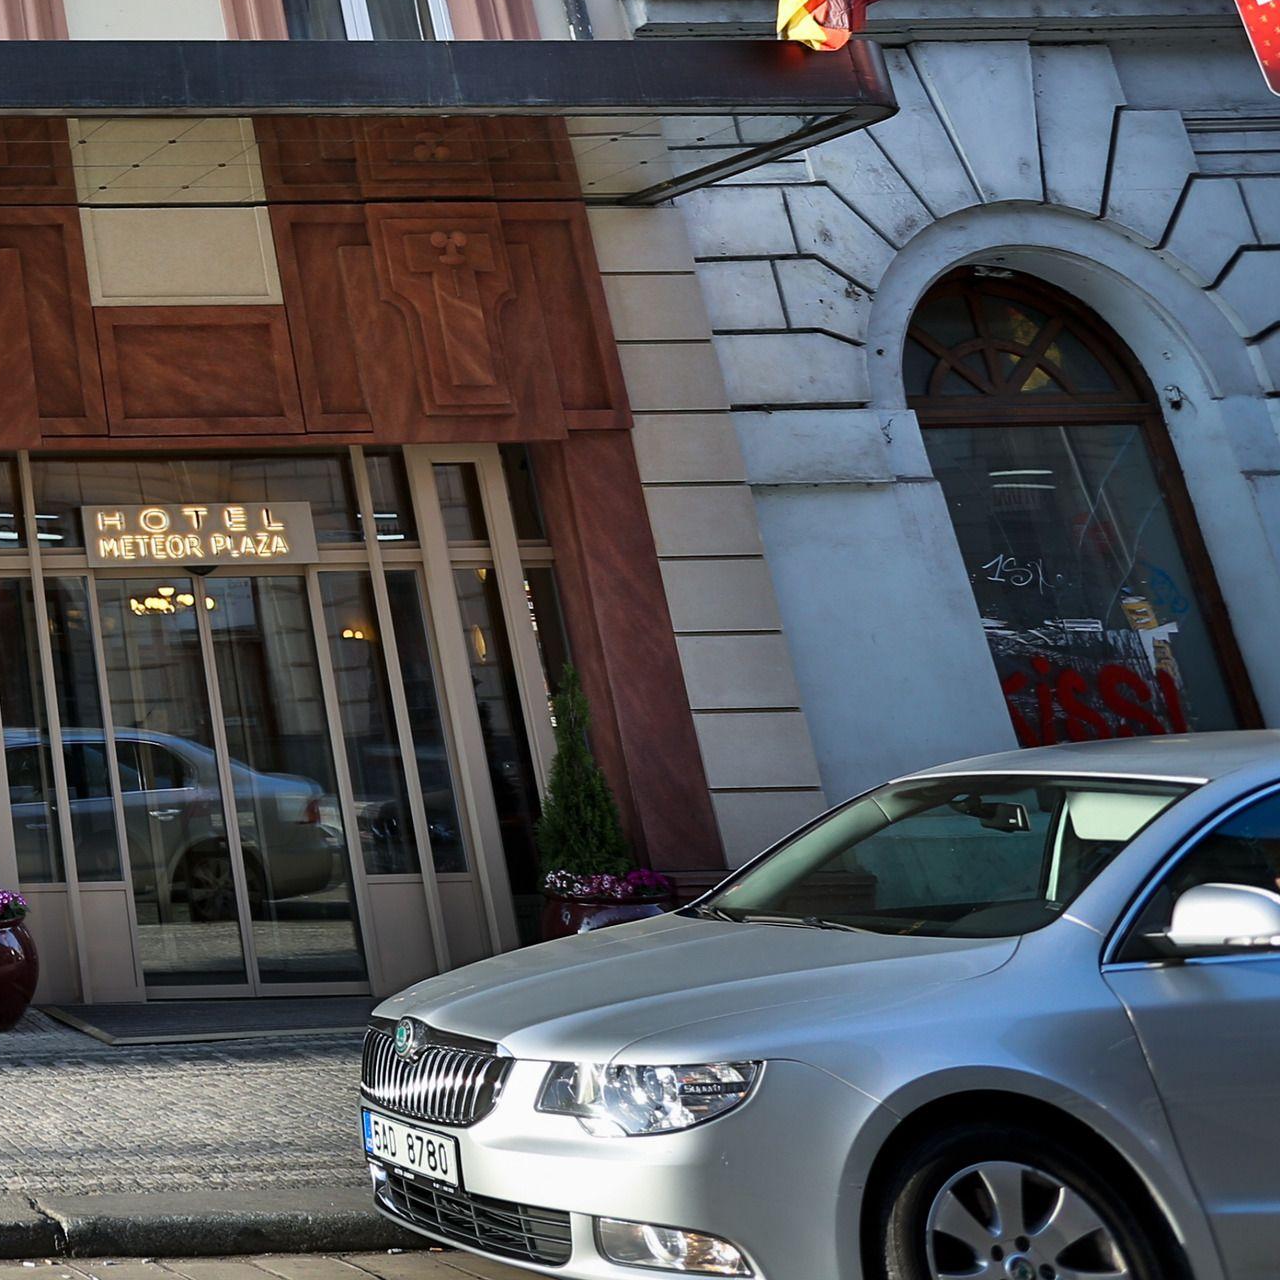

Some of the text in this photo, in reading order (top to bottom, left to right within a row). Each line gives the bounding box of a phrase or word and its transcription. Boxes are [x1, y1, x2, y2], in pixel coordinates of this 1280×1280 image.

[97, 507, 285, 532] HOTEL
[99, 533, 289, 559] METEOR PLAZA
[406, 1133, 448, 1175] 8780
